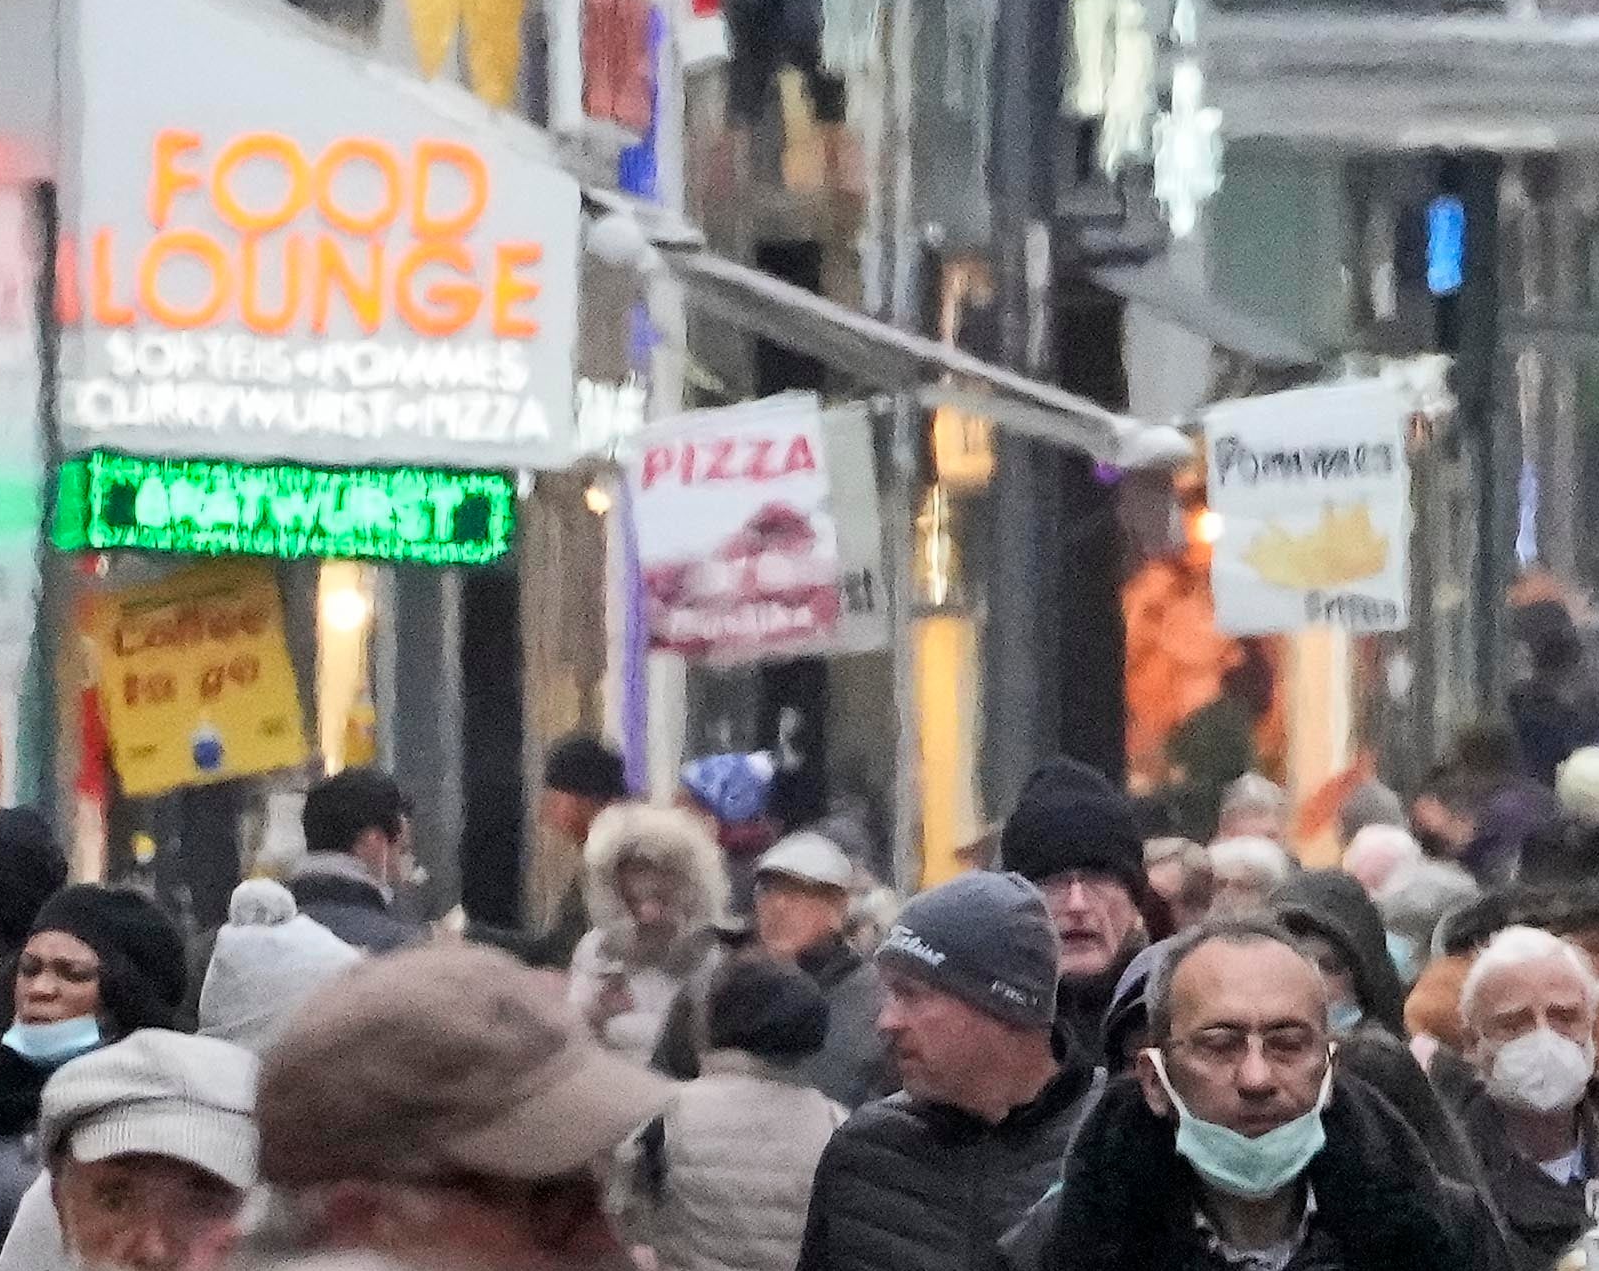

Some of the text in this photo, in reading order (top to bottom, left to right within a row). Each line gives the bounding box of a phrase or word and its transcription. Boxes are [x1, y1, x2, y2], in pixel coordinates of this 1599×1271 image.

[147, 127, 491, 238] FOOD
[91, 228, 545, 339] LOUNGE
[641, 433, 817, 490] PIZZA
[198, 652, 261, 704] go
